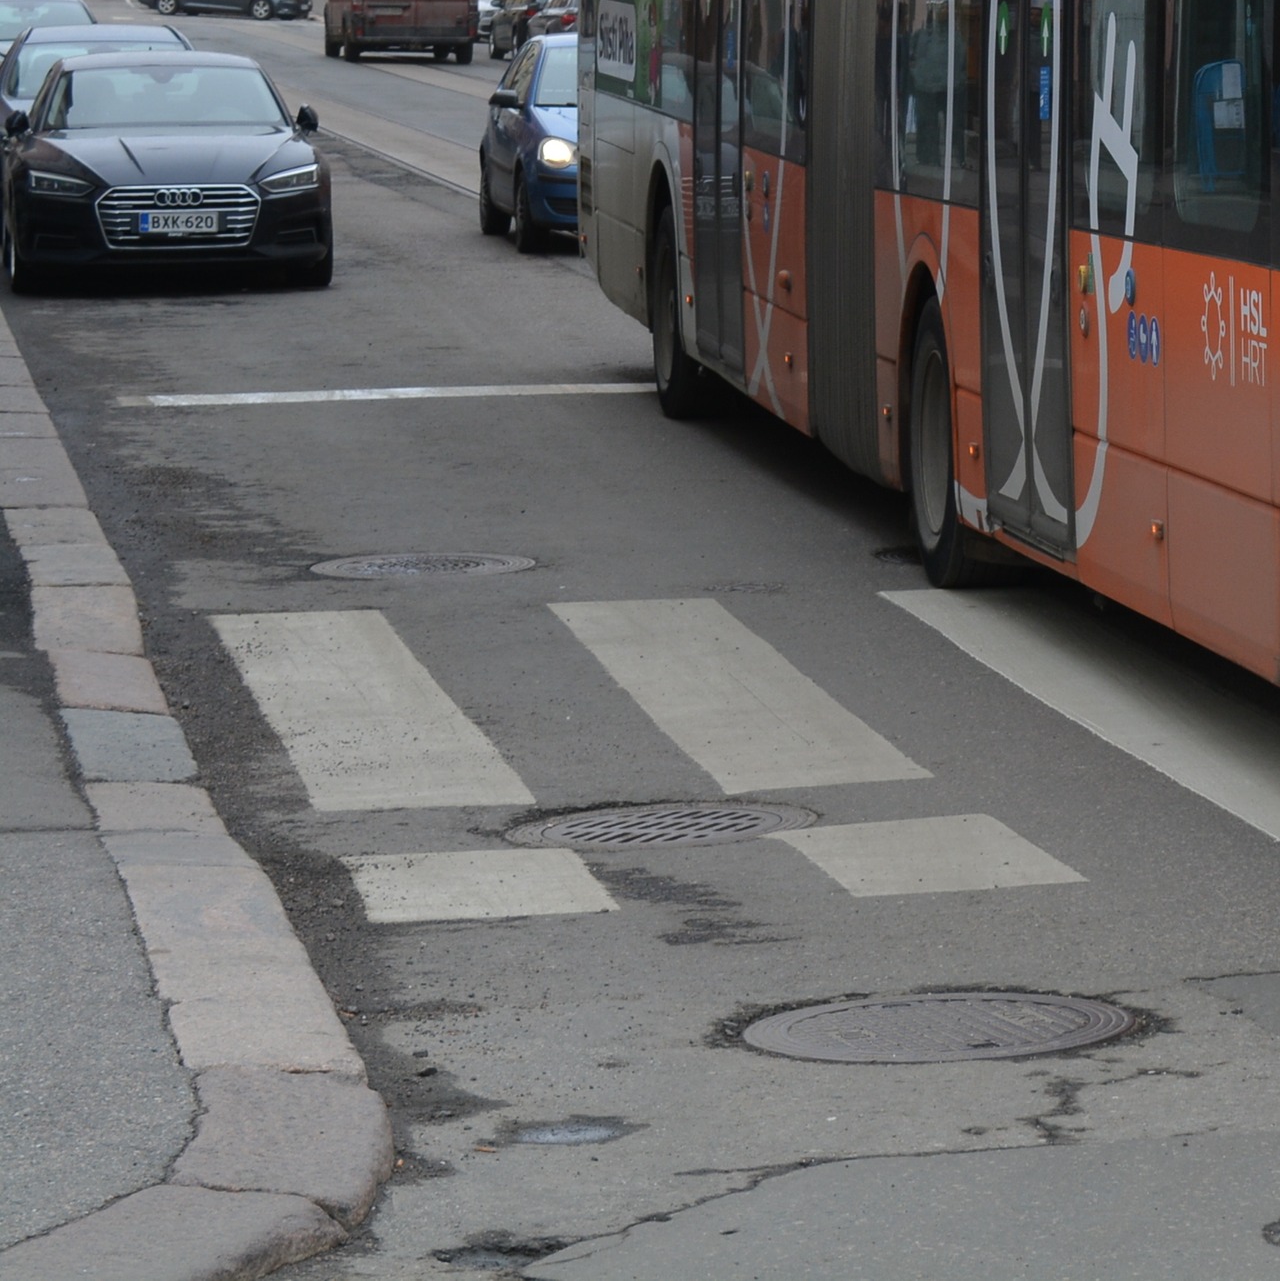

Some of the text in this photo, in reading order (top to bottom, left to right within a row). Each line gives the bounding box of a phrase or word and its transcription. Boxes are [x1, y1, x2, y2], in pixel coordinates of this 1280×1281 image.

[152, 215, 214, 230] BXK-620
[1240, 287, 1268, 338] HSL
[1241, 337, 1268, 387] HRT
